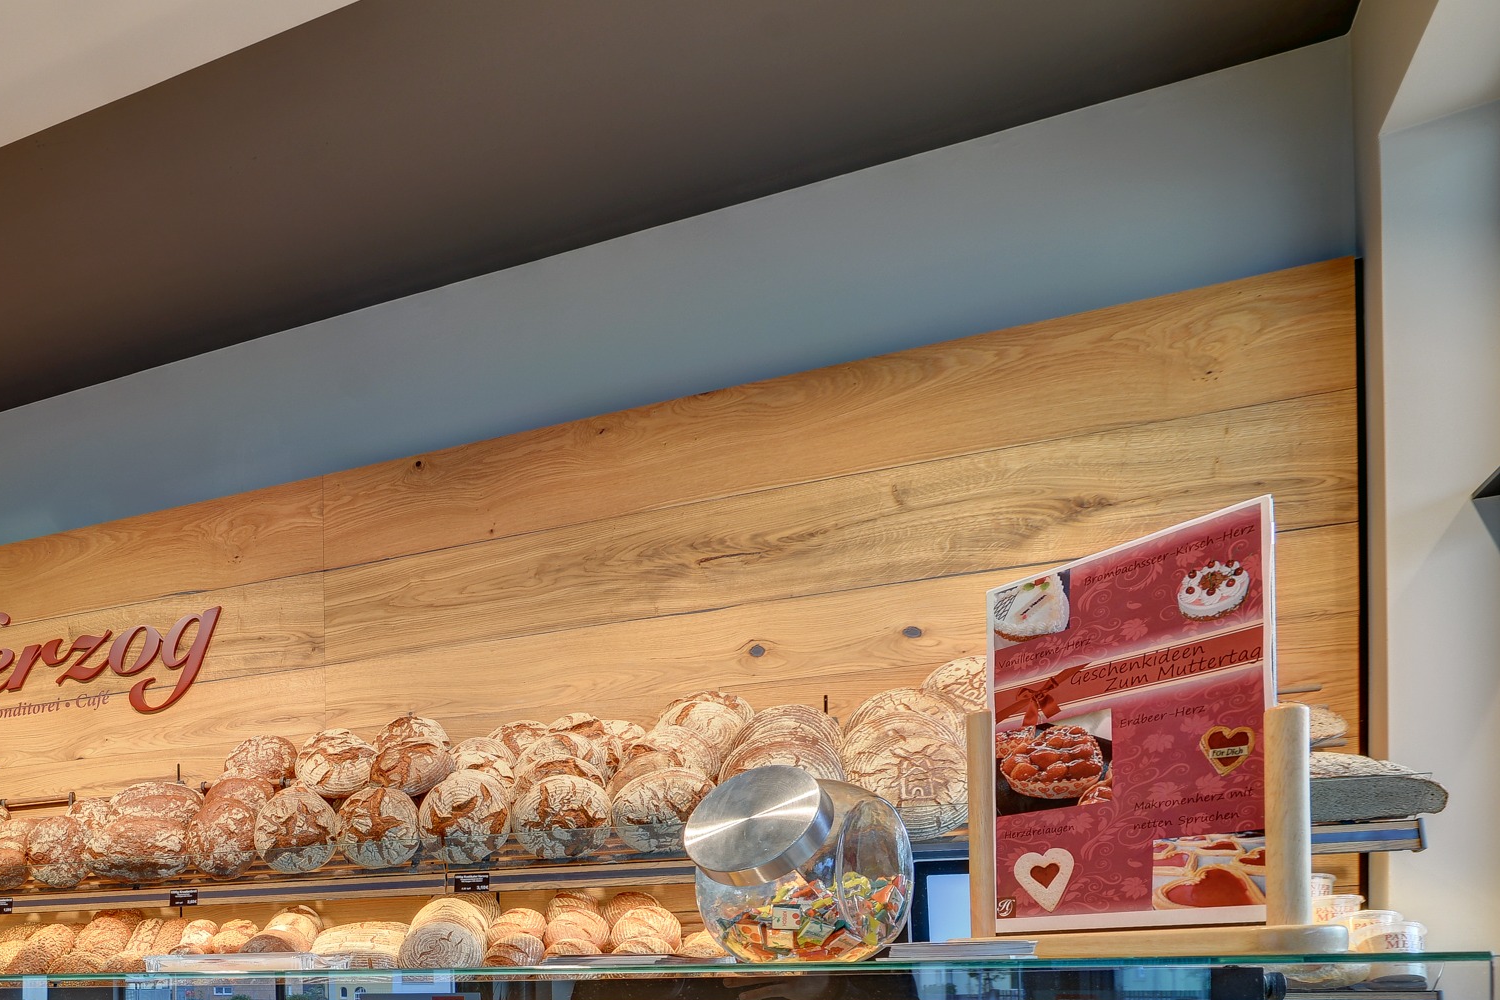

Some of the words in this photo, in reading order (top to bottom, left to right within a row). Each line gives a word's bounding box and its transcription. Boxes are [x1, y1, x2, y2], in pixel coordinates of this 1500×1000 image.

[998, 637, 1092, 669] Vanillecreme-Herz
[1070, 645, 1204, 686] Geschenkideen
[1103, 674, 1149, 693] Zum
[1157, 646, 1263, 679] Muttertag
[75, 691, 111, 710] Café
[1119, 703, 1207, 729] Erdbeer-Herz
[1226, 747, 1244, 757] Dich
[1133, 793, 1225, 812] Makronenherz
[1229, 787, 1254, 798] mit
[1004, 824, 1076, 840] Herzdreiaugen
[1133, 819, 1173, 831] netten
[1178, 810, 1240, 829] Sprüchen
